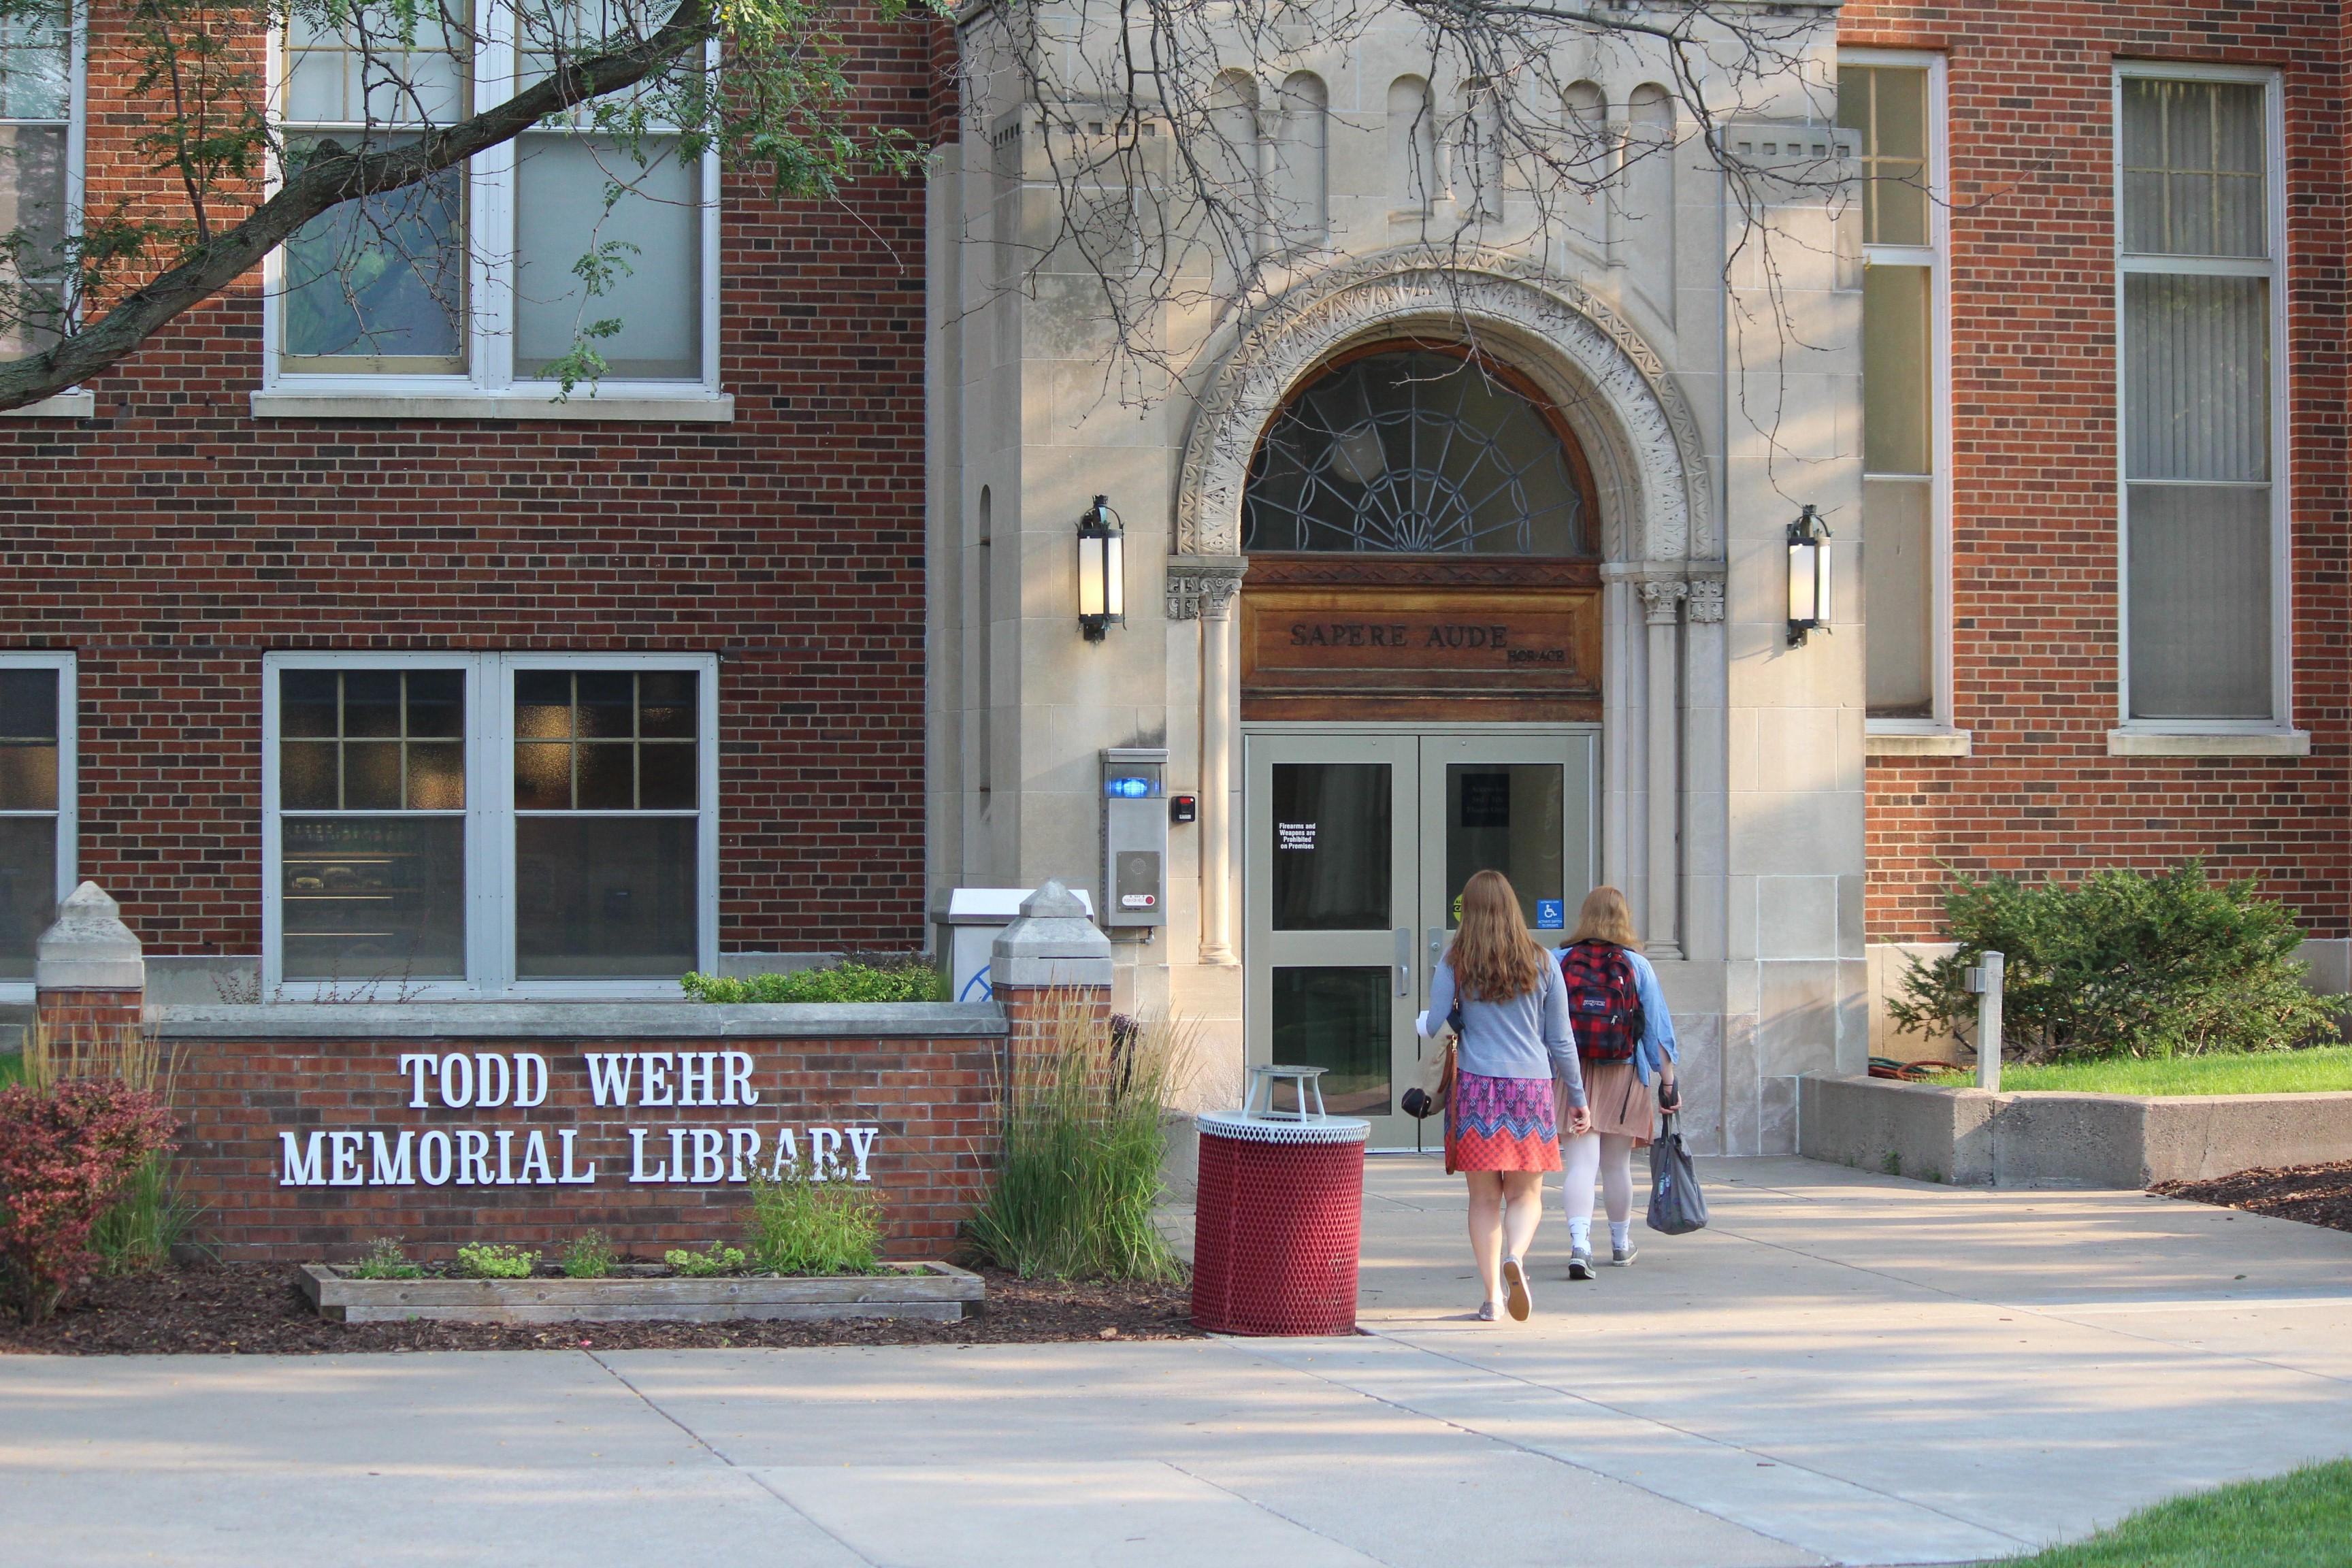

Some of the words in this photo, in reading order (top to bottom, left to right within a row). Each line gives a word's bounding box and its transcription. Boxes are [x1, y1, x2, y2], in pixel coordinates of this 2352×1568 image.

[1290, 623, 1407, 647] SAPERE
[1424, 625, 1507, 649] AUDE
[1507, 649, 1565, 662] HORACE
[401, 1052, 547, 1108] TODD
[585, 1051, 759, 1106] WEHR
[279, 1130, 595, 1186] MEMORIAL
[629, 1128, 879, 1183] LIBRARY
